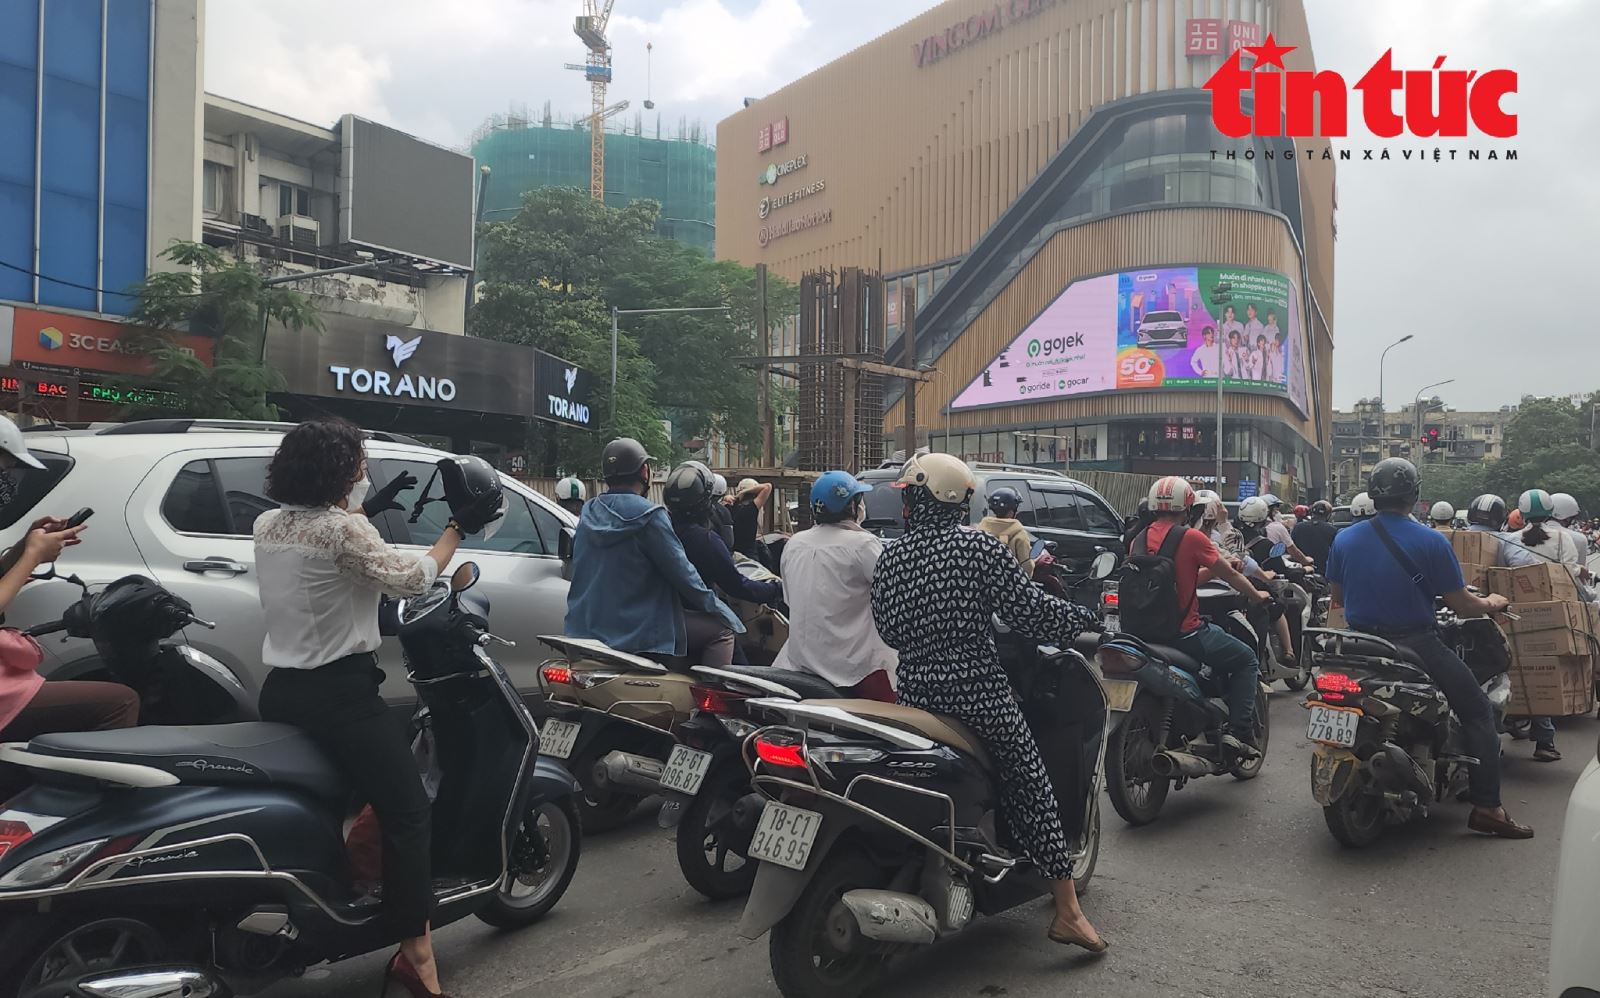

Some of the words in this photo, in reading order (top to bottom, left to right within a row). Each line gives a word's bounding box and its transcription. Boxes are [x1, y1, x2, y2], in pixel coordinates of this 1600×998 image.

[914, 5, 1003, 67] VINCOM
[1233, 24, 1256, 40] UNI
[771, 192, 794, 210] ELITE
[795, 179, 826, 202] FITNESS
[1043, 332, 1084, 356] gojek
[330, 365, 457, 402] TORANO
[1027, 382, 1051, 393] goride
[1067, 377, 1089, 388] gocar
[548, 394, 590, 425] TORANO
[1316, 708, 1351, 728] 29-E1
[186, 759, 254, 774] Grande
[672, 748, 705, 772] 29-G1
[661, 766, 700, 791] 096.87
[769, 808, 812, 838] 18-C1
[126, 849, 199, 870] Grande
[753, 831, 808, 865] 346.95
